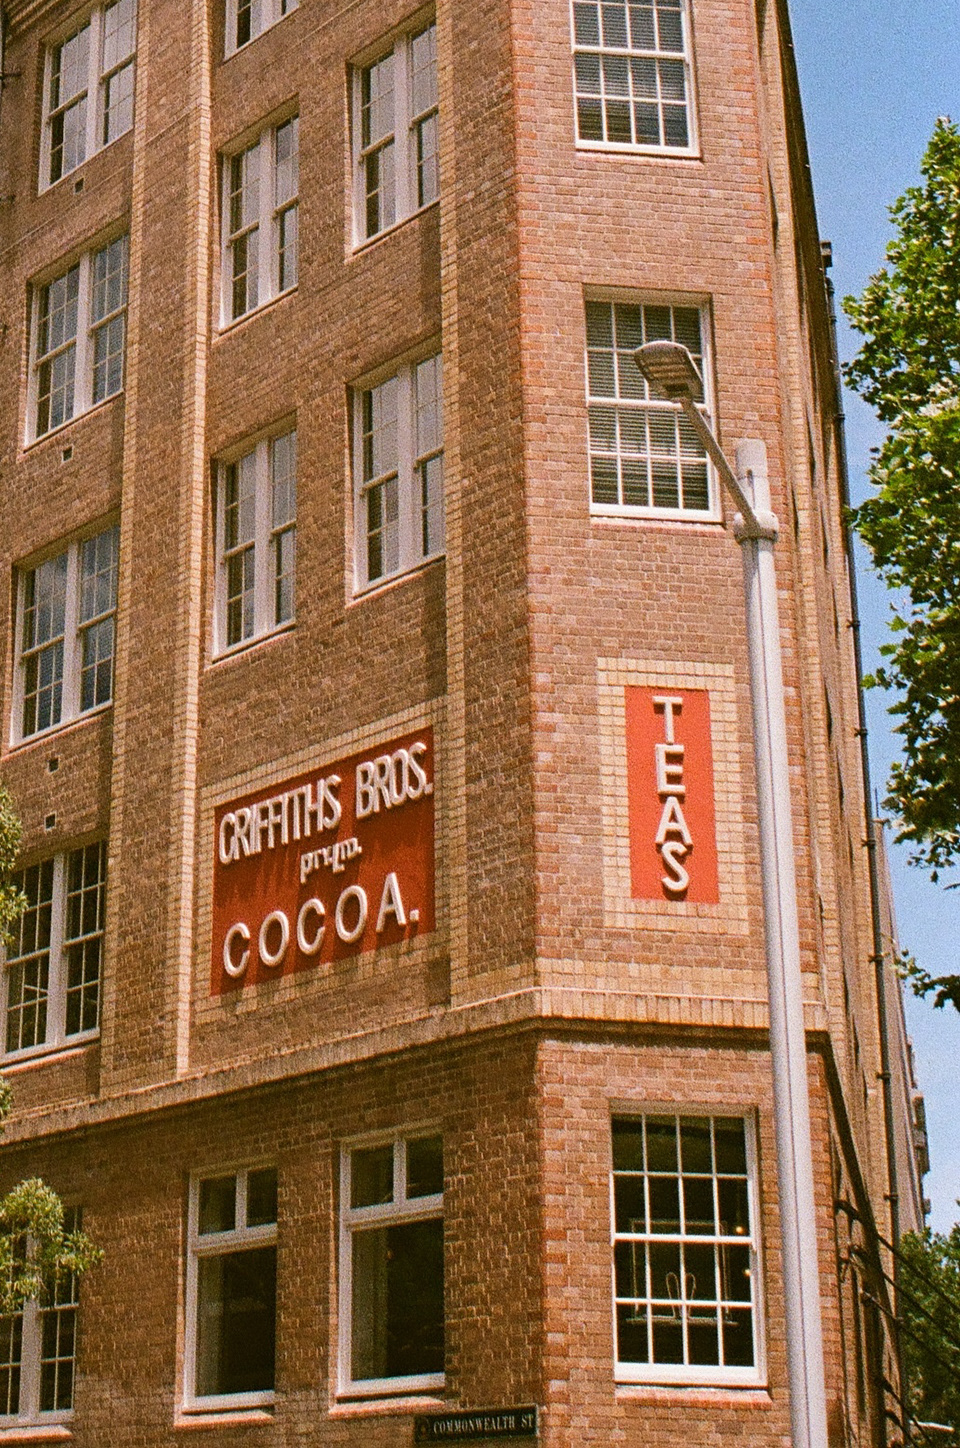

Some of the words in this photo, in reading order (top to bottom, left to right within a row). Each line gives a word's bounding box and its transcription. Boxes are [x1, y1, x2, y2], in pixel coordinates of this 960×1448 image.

[219, 774, 342, 865] GRIFFITHS
[356, 742, 434, 819] BROS.
[652, 695, 693, 893] TEAS
[223, 872, 420, 978] COCOA.
[433, 1415, 515, 1435] COMMONWEALTH
[521, 1414, 534, 1428] ST
